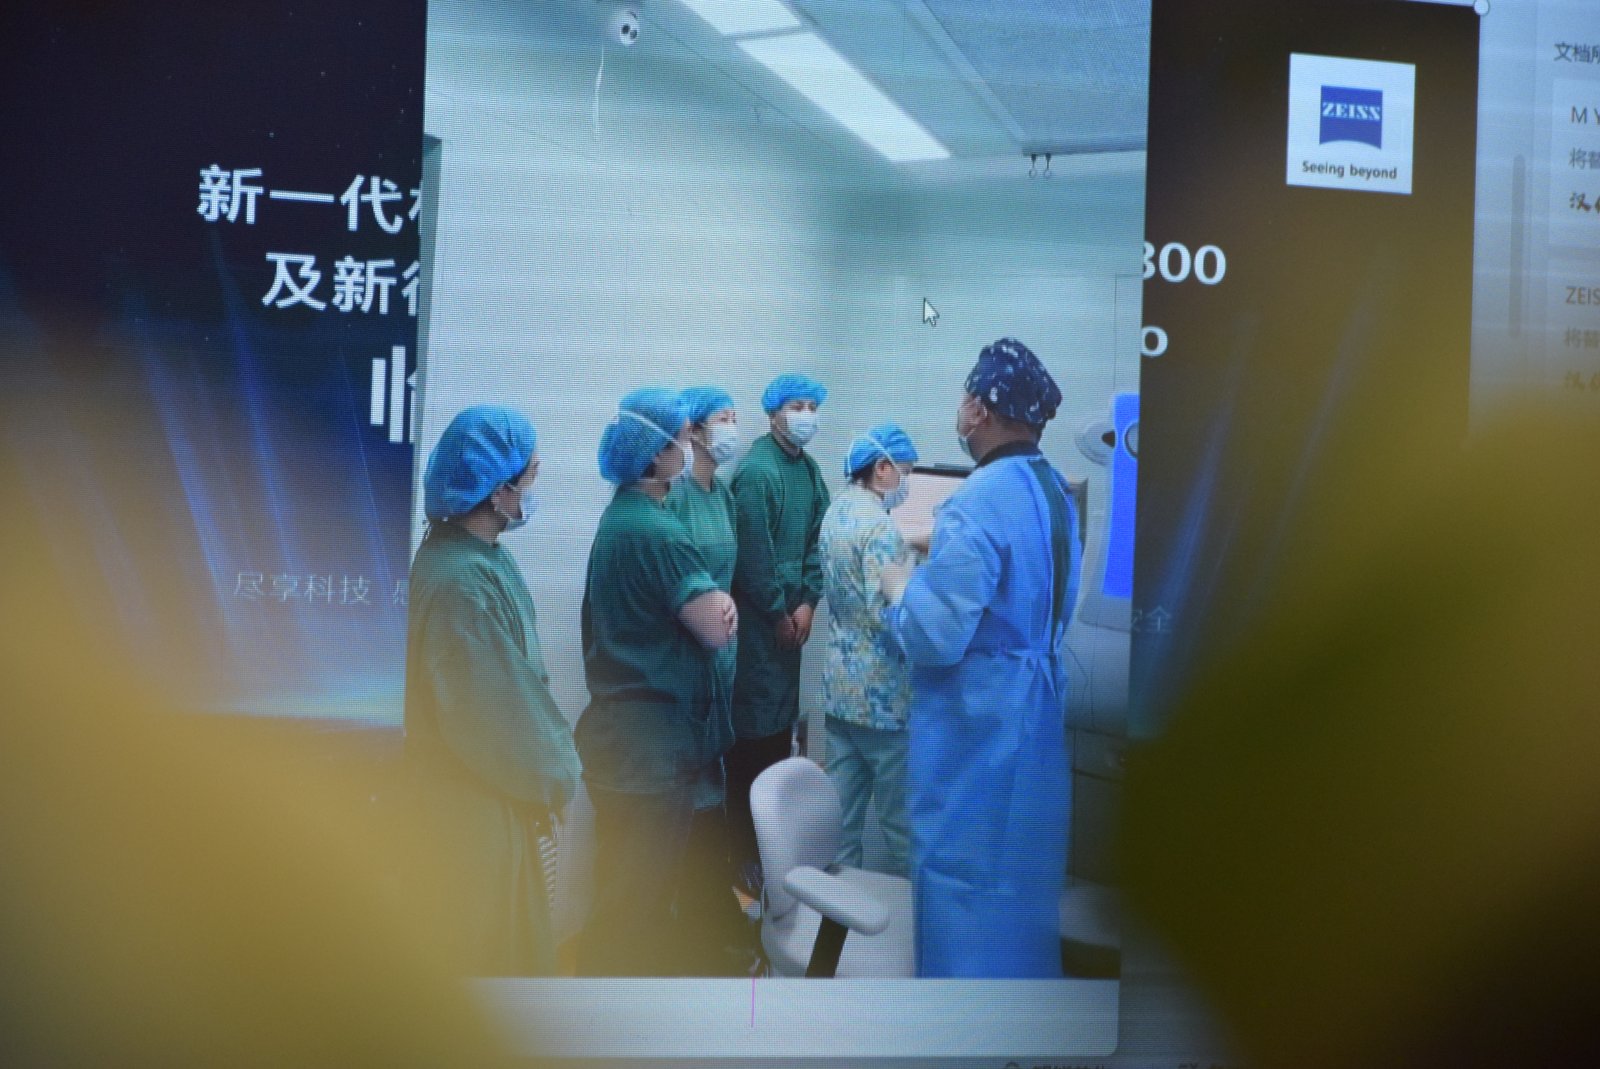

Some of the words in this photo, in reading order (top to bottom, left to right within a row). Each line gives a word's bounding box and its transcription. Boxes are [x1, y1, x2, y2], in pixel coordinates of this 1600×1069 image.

[1322, 101, 1381, 121] ZEISS
[1302, 160, 1345, 178] Seeing
[1349, 163, 1398, 180] beyond
[233, 571, 372, 606] 尽享科技
